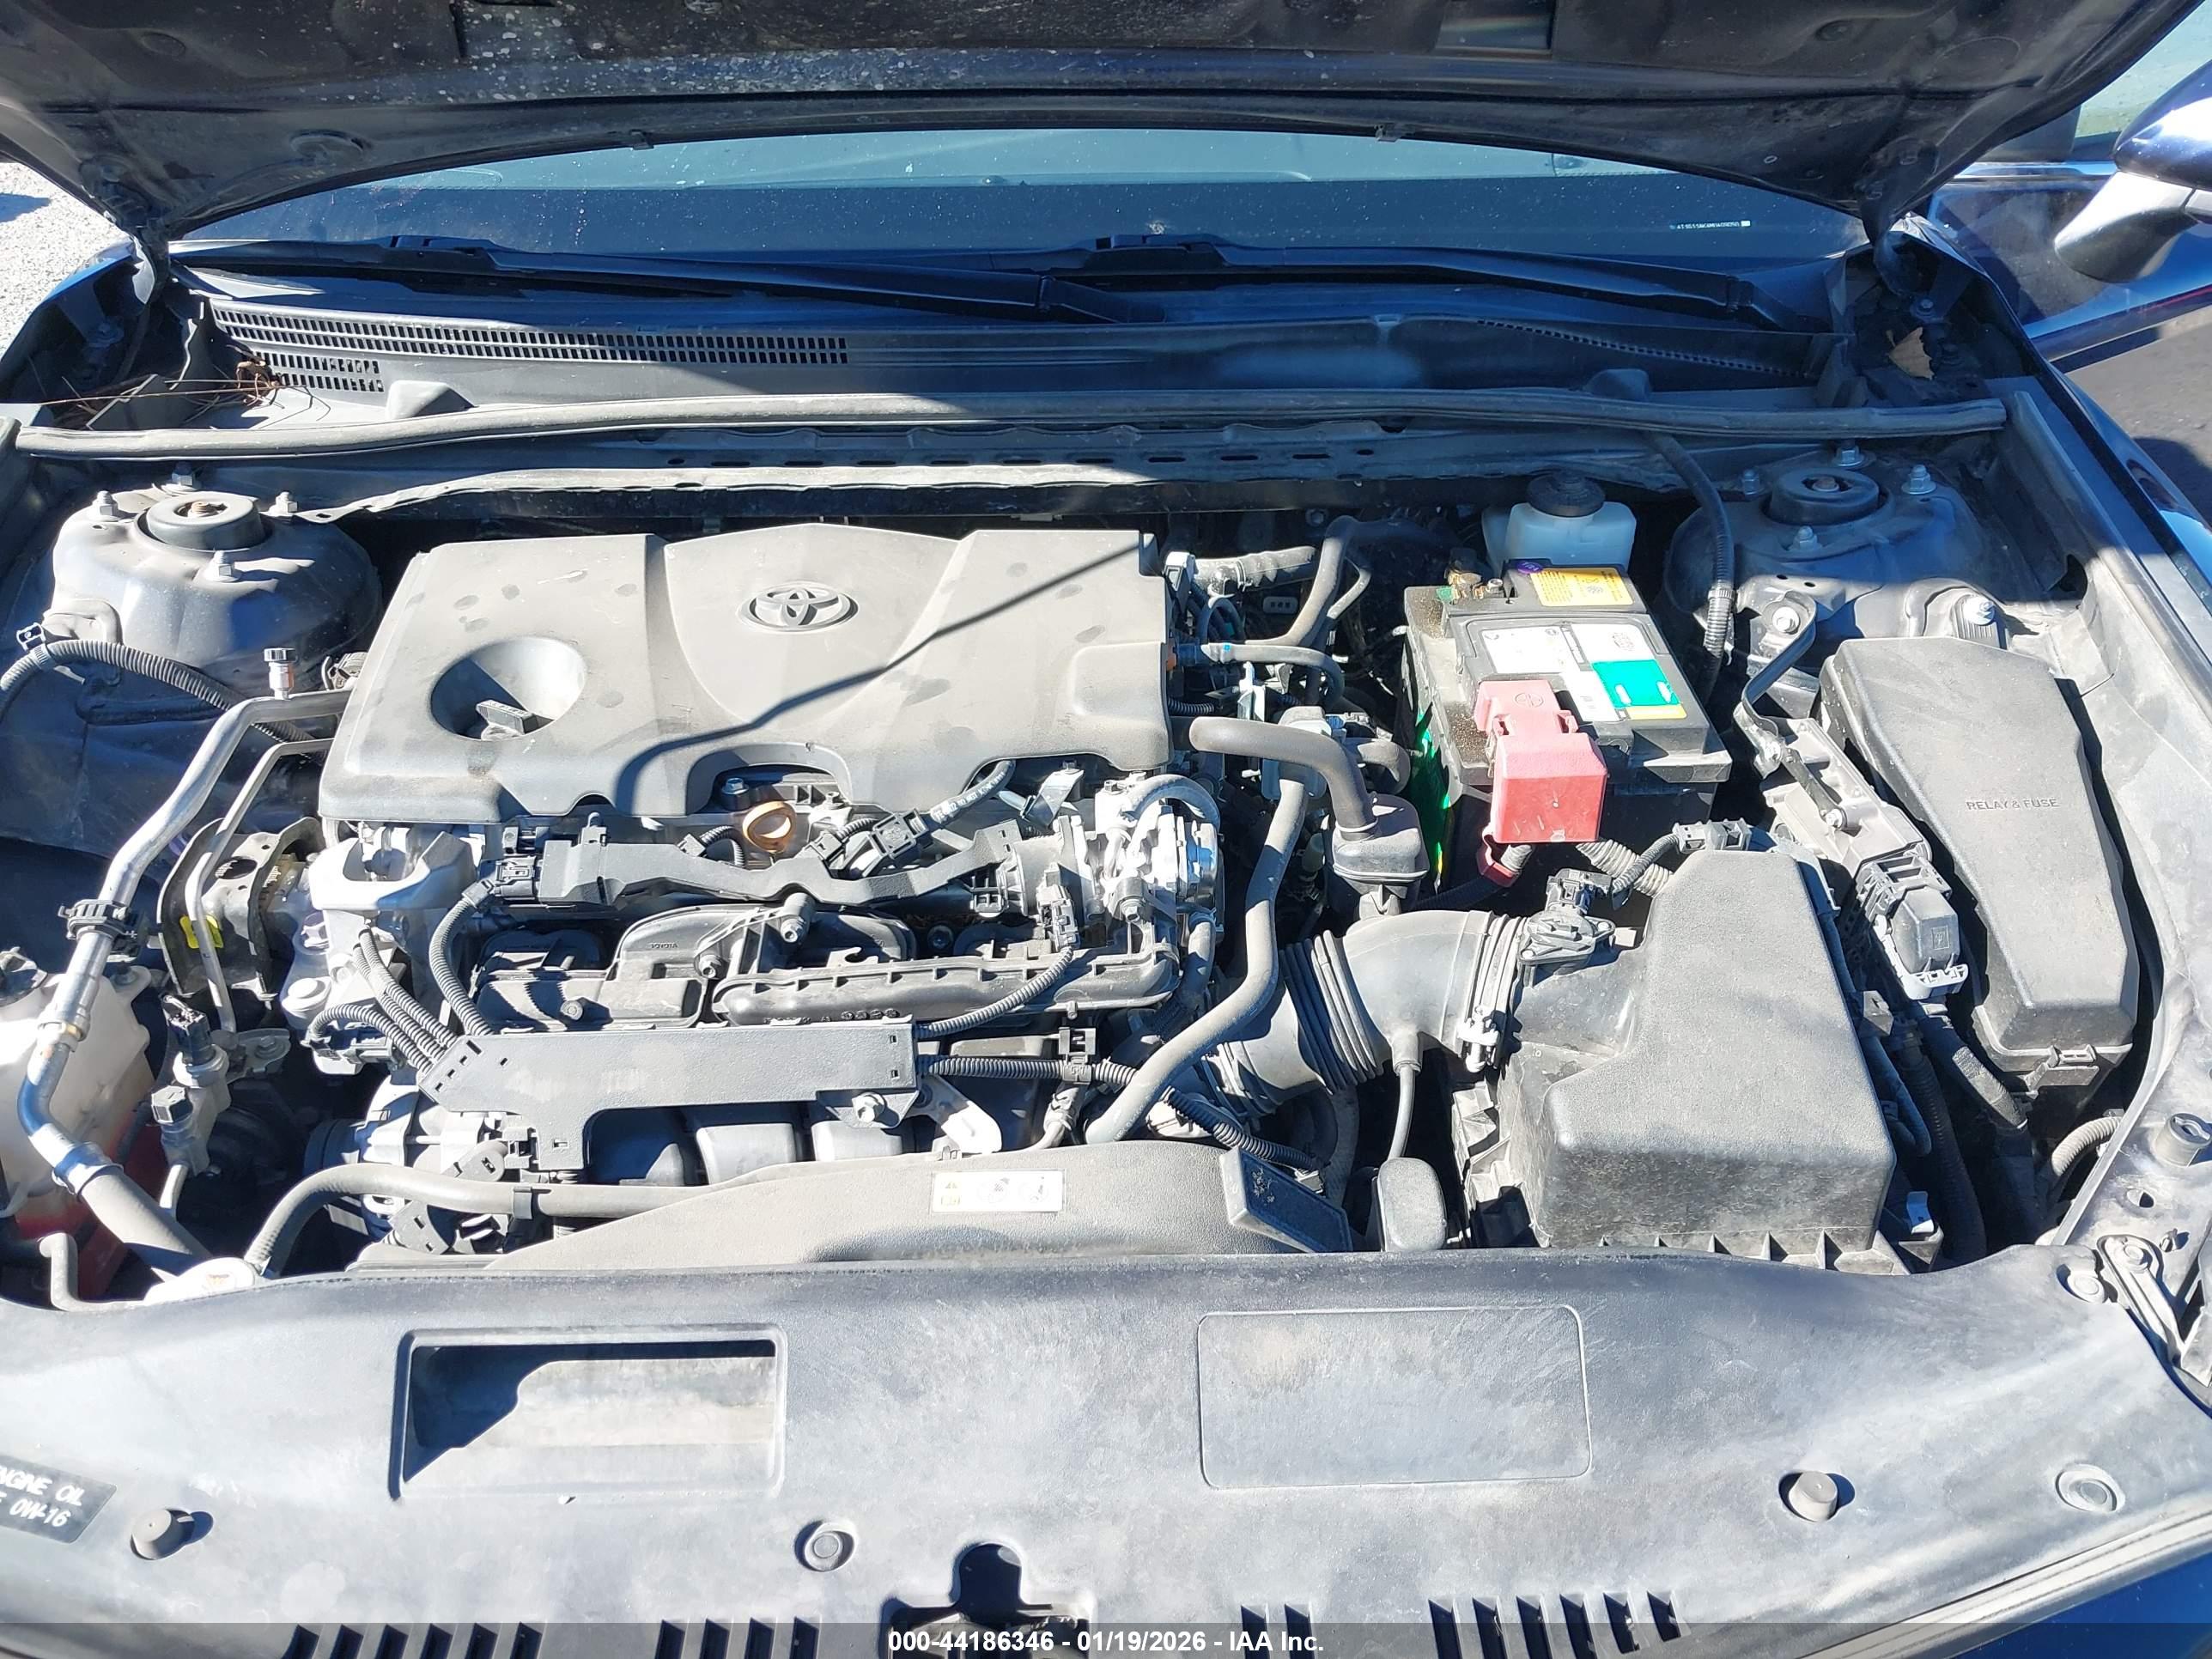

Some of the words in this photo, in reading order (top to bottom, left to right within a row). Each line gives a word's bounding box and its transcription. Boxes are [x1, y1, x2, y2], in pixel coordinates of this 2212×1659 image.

[1966, 800, 2008, 810] RELAY
[2023, 799, 2060, 808] FUSE
[0, 1465, 52, 1495] NGINE
[55, 1485, 85, 1506] OIL
